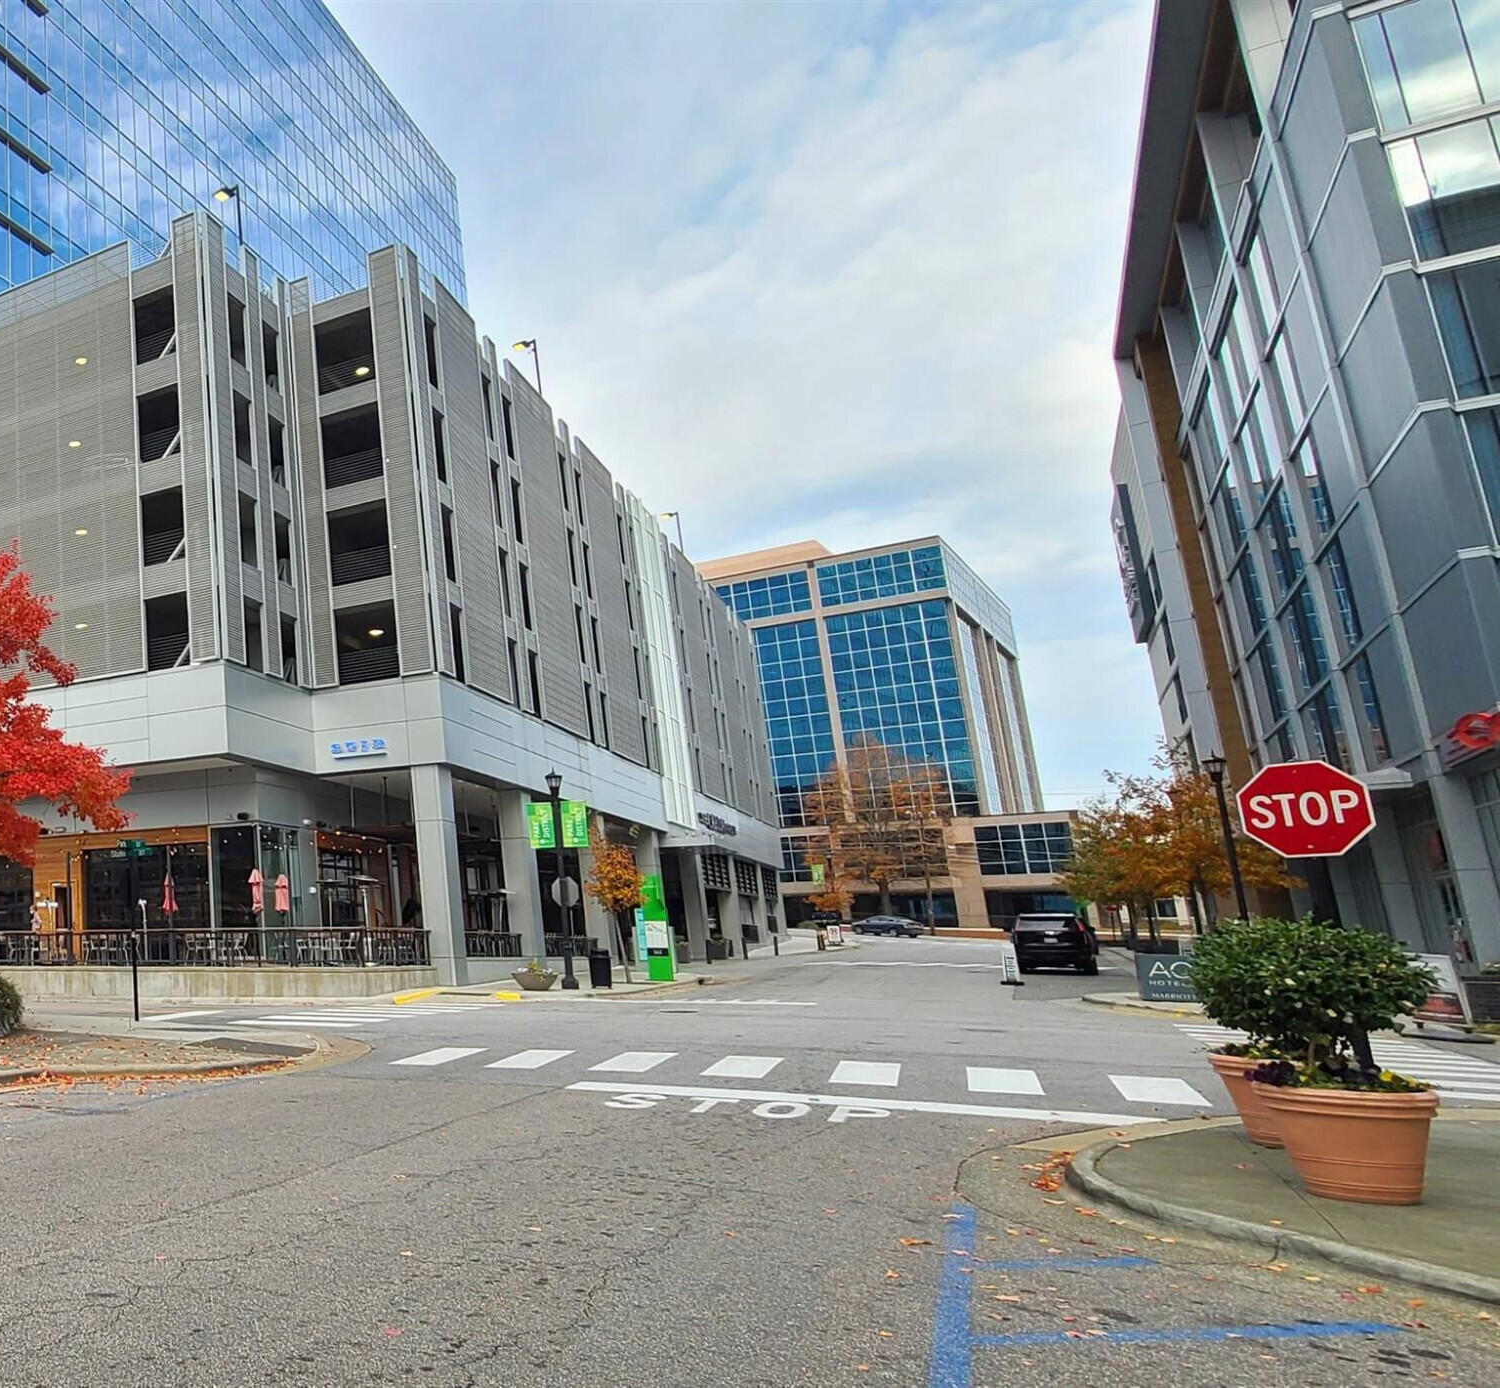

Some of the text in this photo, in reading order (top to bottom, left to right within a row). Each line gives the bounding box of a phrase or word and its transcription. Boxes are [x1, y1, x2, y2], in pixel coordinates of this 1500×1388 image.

[1249, 789, 1359, 829] STOP
[1148, 961, 1194, 980] AC
[604, 1093, 891, 1122] STOP
